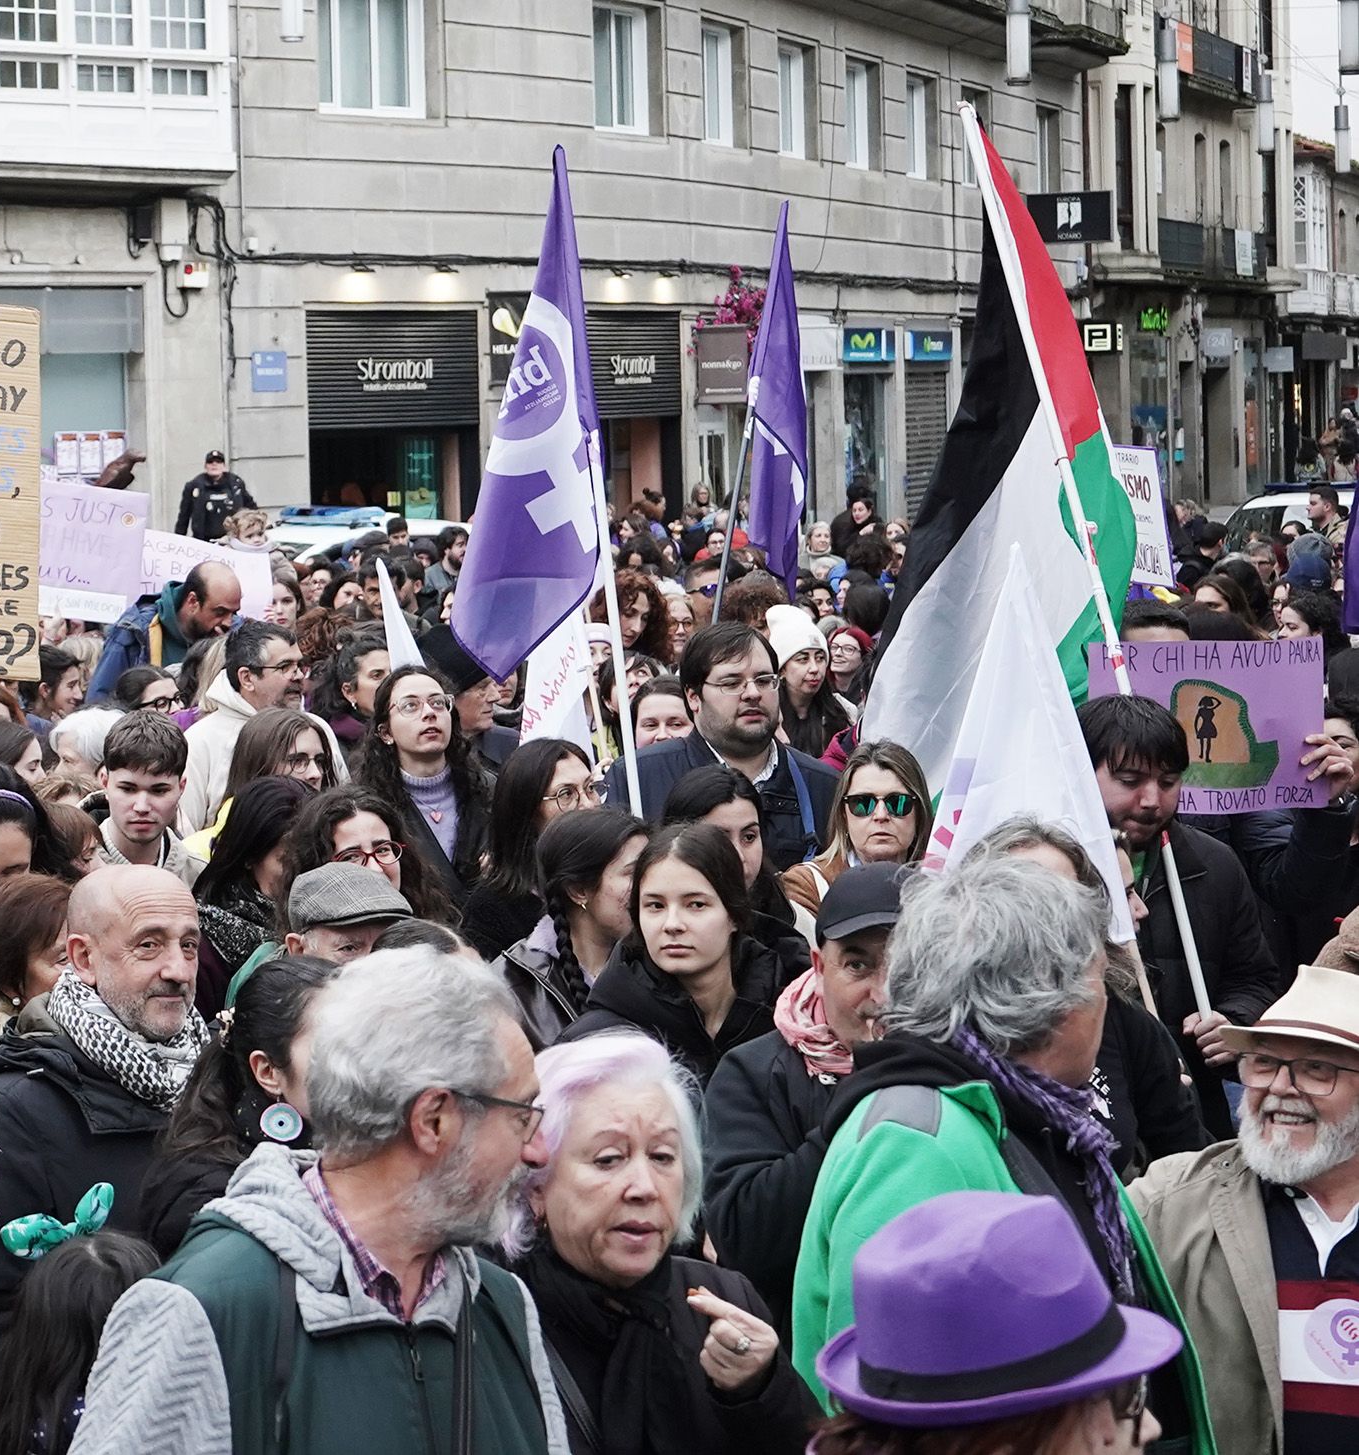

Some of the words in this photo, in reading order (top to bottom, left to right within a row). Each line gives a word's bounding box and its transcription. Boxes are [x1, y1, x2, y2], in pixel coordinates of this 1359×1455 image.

[1057, 232, 1082, 240] NOTARIO
[492, 344, 518, 354] HELA
[357, 357, 433, 380] Stromboli
[611, 354, 655, 375] Stromboli
[702, 360, 742, 370] nonna&go
[1116, 452, 1139, 465] TRARIO
[1121, 474, 1151, 503] ISMO
[66, 498, 123, 525] JUST
[39, 565, 90, 584] un...
[143, 559, 162, 577] UE
[1103, 643, 1137, 672] PR
[1153, 645, 1184, 673] CHI
[1194, 643, 1221, 669] HA
[1231, 641, 1281, 669] AVUTO
[1288, 640, 1320, 665] PAURA
[1203, 787, 1266, 812] TROVATO
[1275, 785, 1313, 804] FORZA
